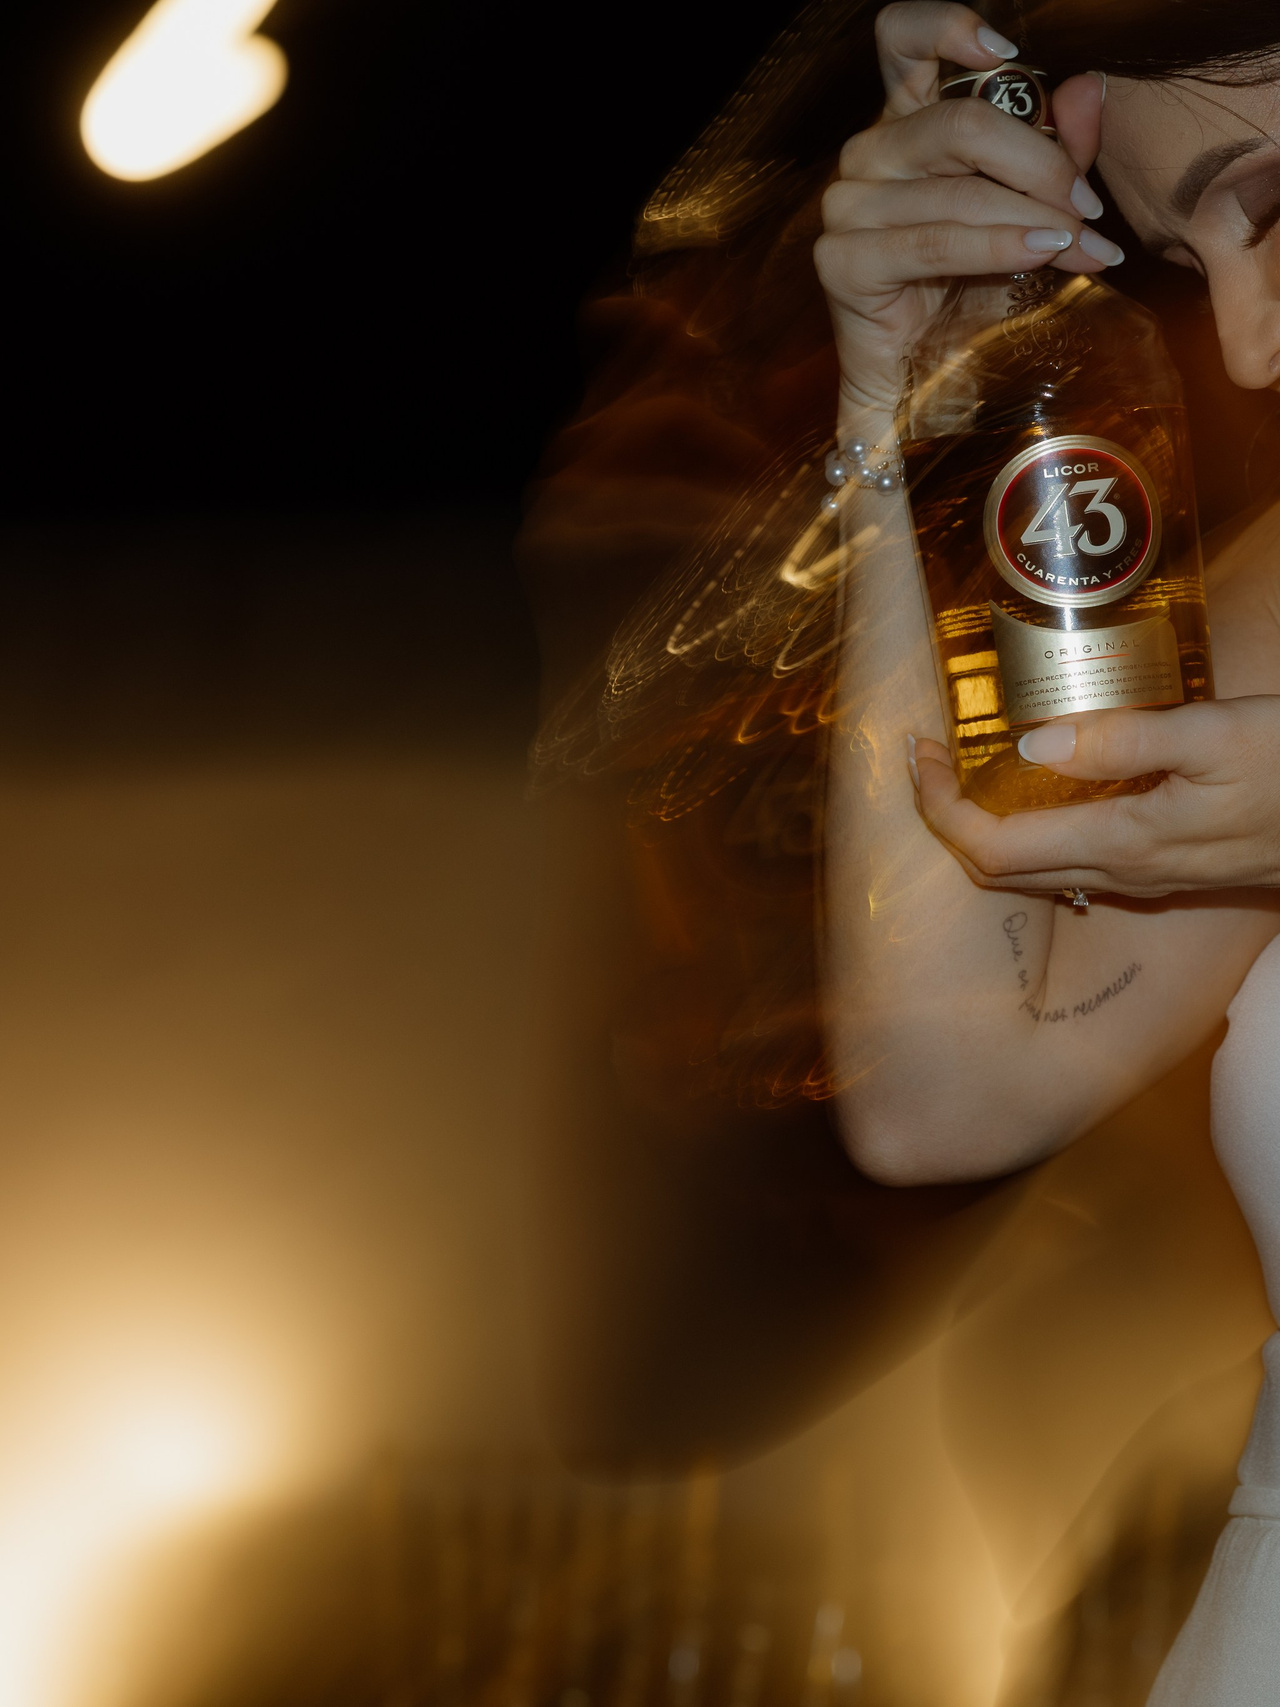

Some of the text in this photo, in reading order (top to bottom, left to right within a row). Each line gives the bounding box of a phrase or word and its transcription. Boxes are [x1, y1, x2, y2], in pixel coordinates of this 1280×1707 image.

[991, 82, 1032, 116] 43
[1043, 462, 1100, 479] LICOR
[1020, 477, 1128, 559] 43
[1016, 537, 1143, 587] CUARENTA Y TRES
[1044, 639, 1140, 659] ORIGINAL
[1046, 673, 1072, 682] RECETA
[1017, 687, 1060, 698] ELABORADA
[1024, 696, 1077, 709] INGREDIENTES
[1002, 911, 1028, 963] Que
